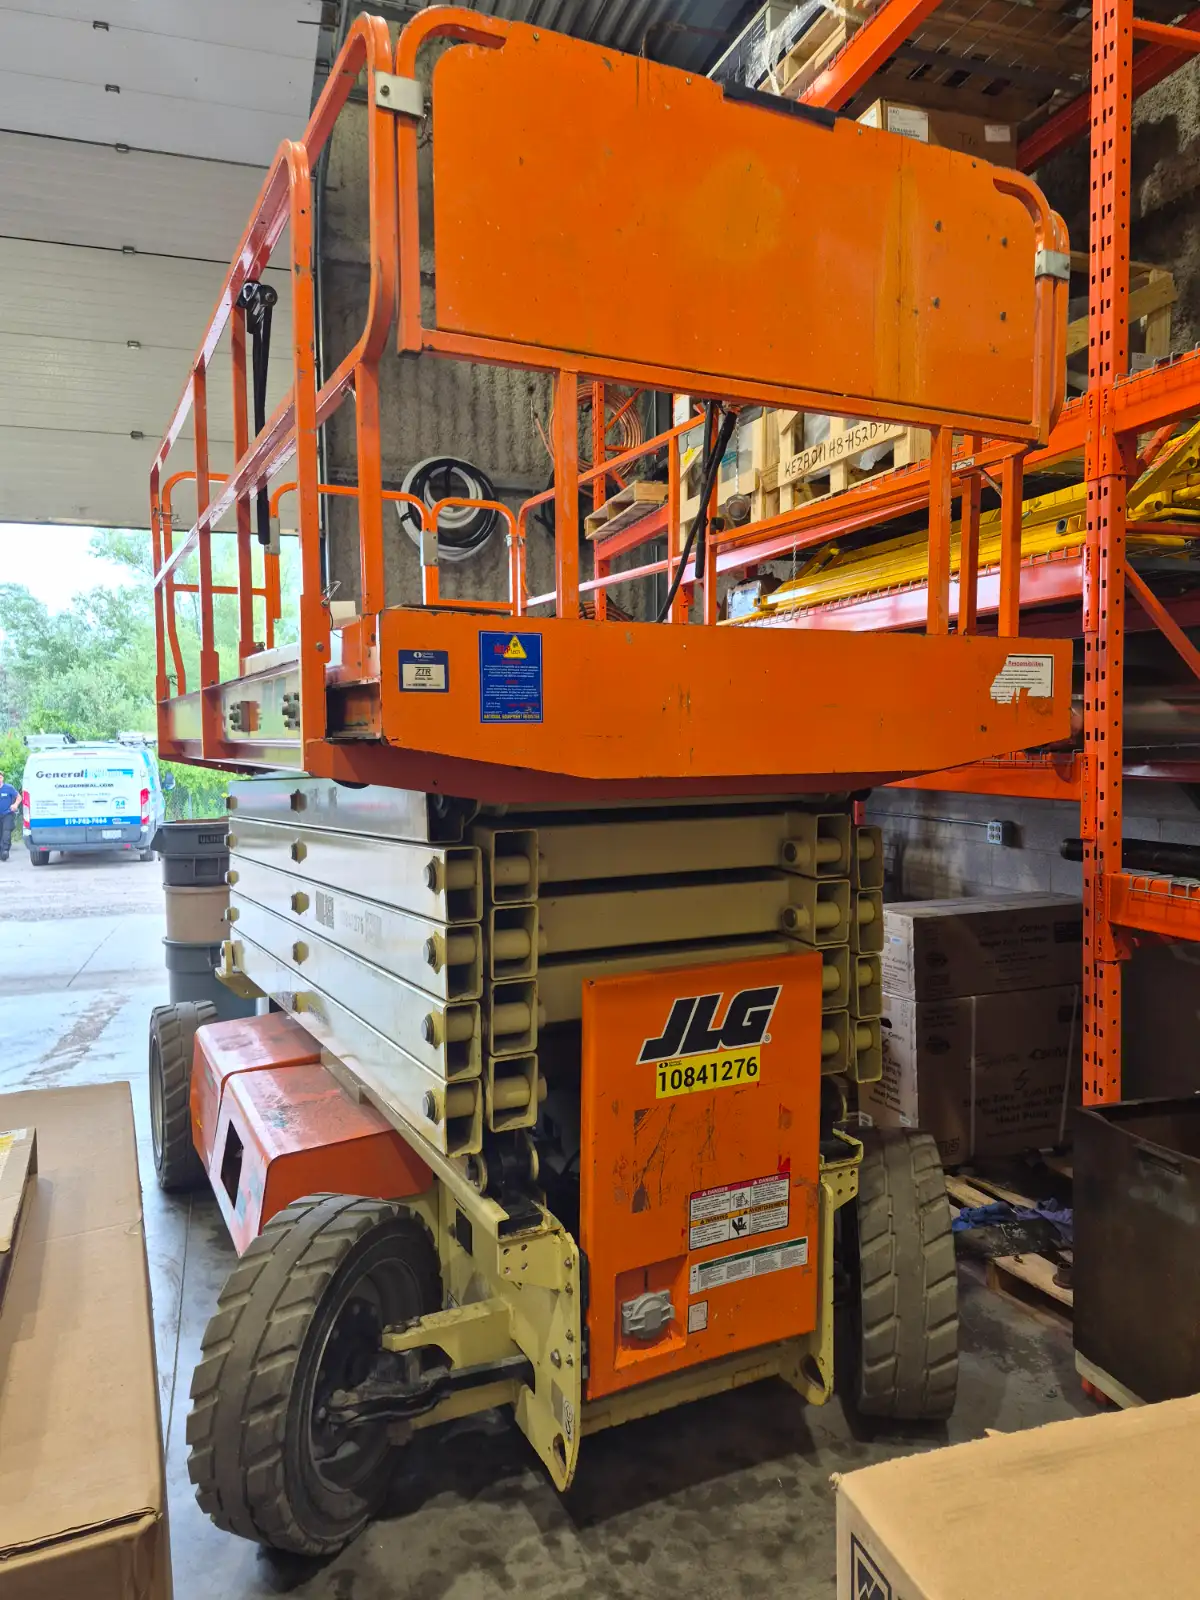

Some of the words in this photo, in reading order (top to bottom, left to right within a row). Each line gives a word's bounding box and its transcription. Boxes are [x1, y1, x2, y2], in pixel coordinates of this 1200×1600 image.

[35, 769, 84, 779] General
[637, 985, 782, 1064] JLG
[658, 1056, 758, 1092] 10841276
[758, 1176, 779, 1184] DANGER
[707, 1187, 728, 1196] DANGER
